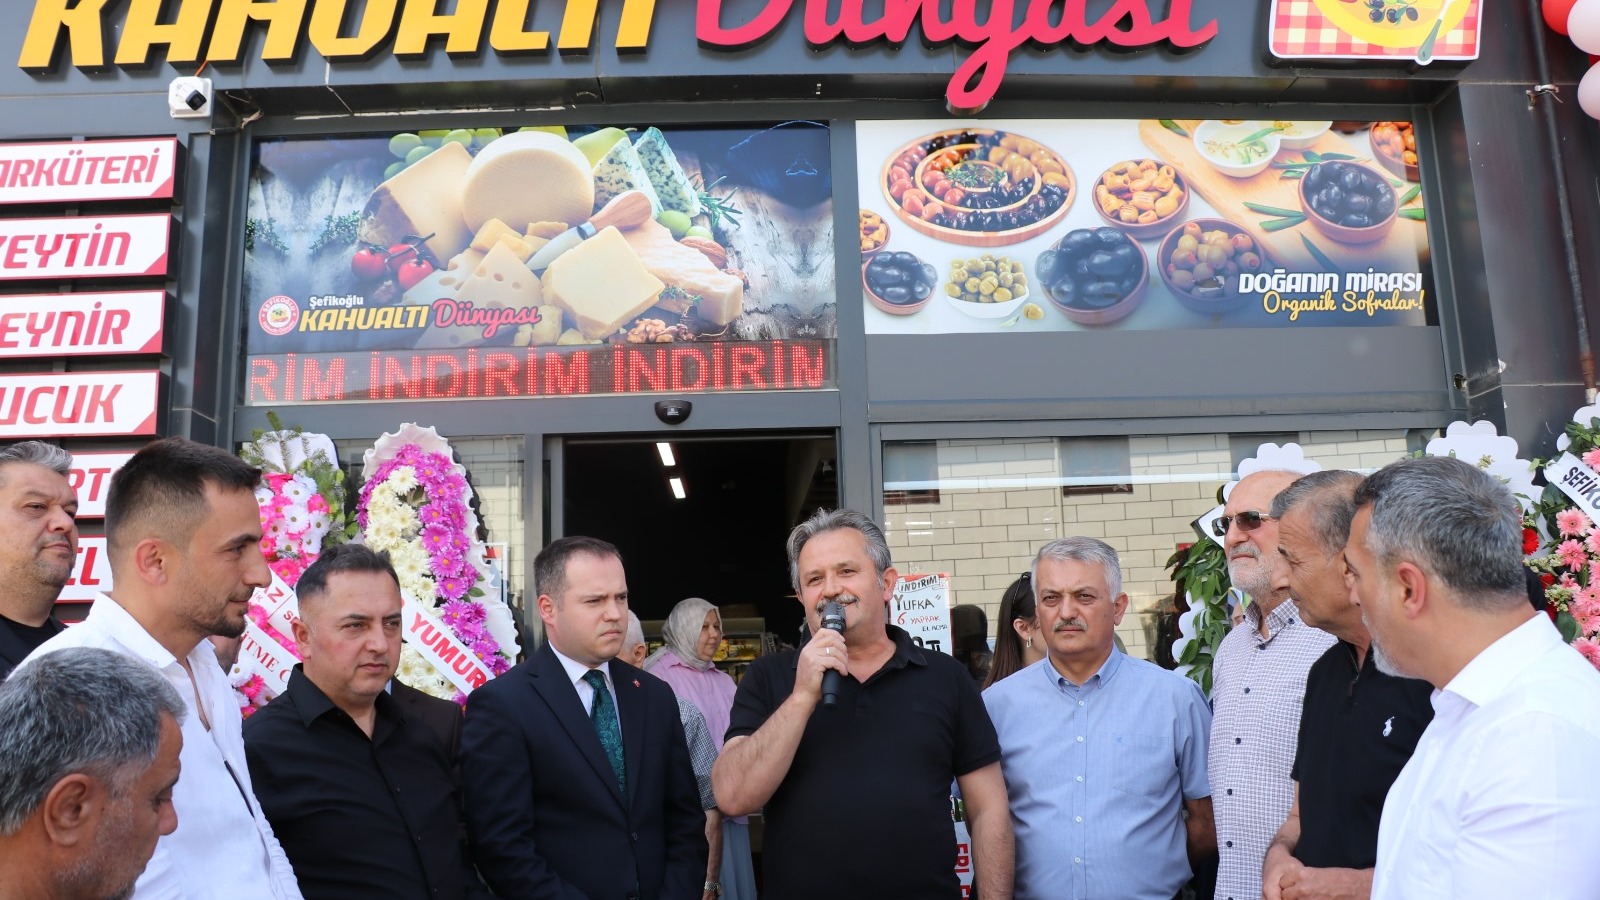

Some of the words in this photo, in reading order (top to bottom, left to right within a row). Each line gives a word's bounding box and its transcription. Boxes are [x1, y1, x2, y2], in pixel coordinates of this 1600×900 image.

[0, 223, 131, 269] EYTİN
[1238, 268, 1340, 294] DOĞANIN
[1345, 268, 1422, 293] MİRASI
[309, 295, 364, 309] Şefikoğlu
[432, 298, 542, 339] Dünyası
[1263, 290, 1337, 321] Organik
[1342, 290, 1425, 316] Sofralar!
[369, 346, 589, 399] İNDİRİM
